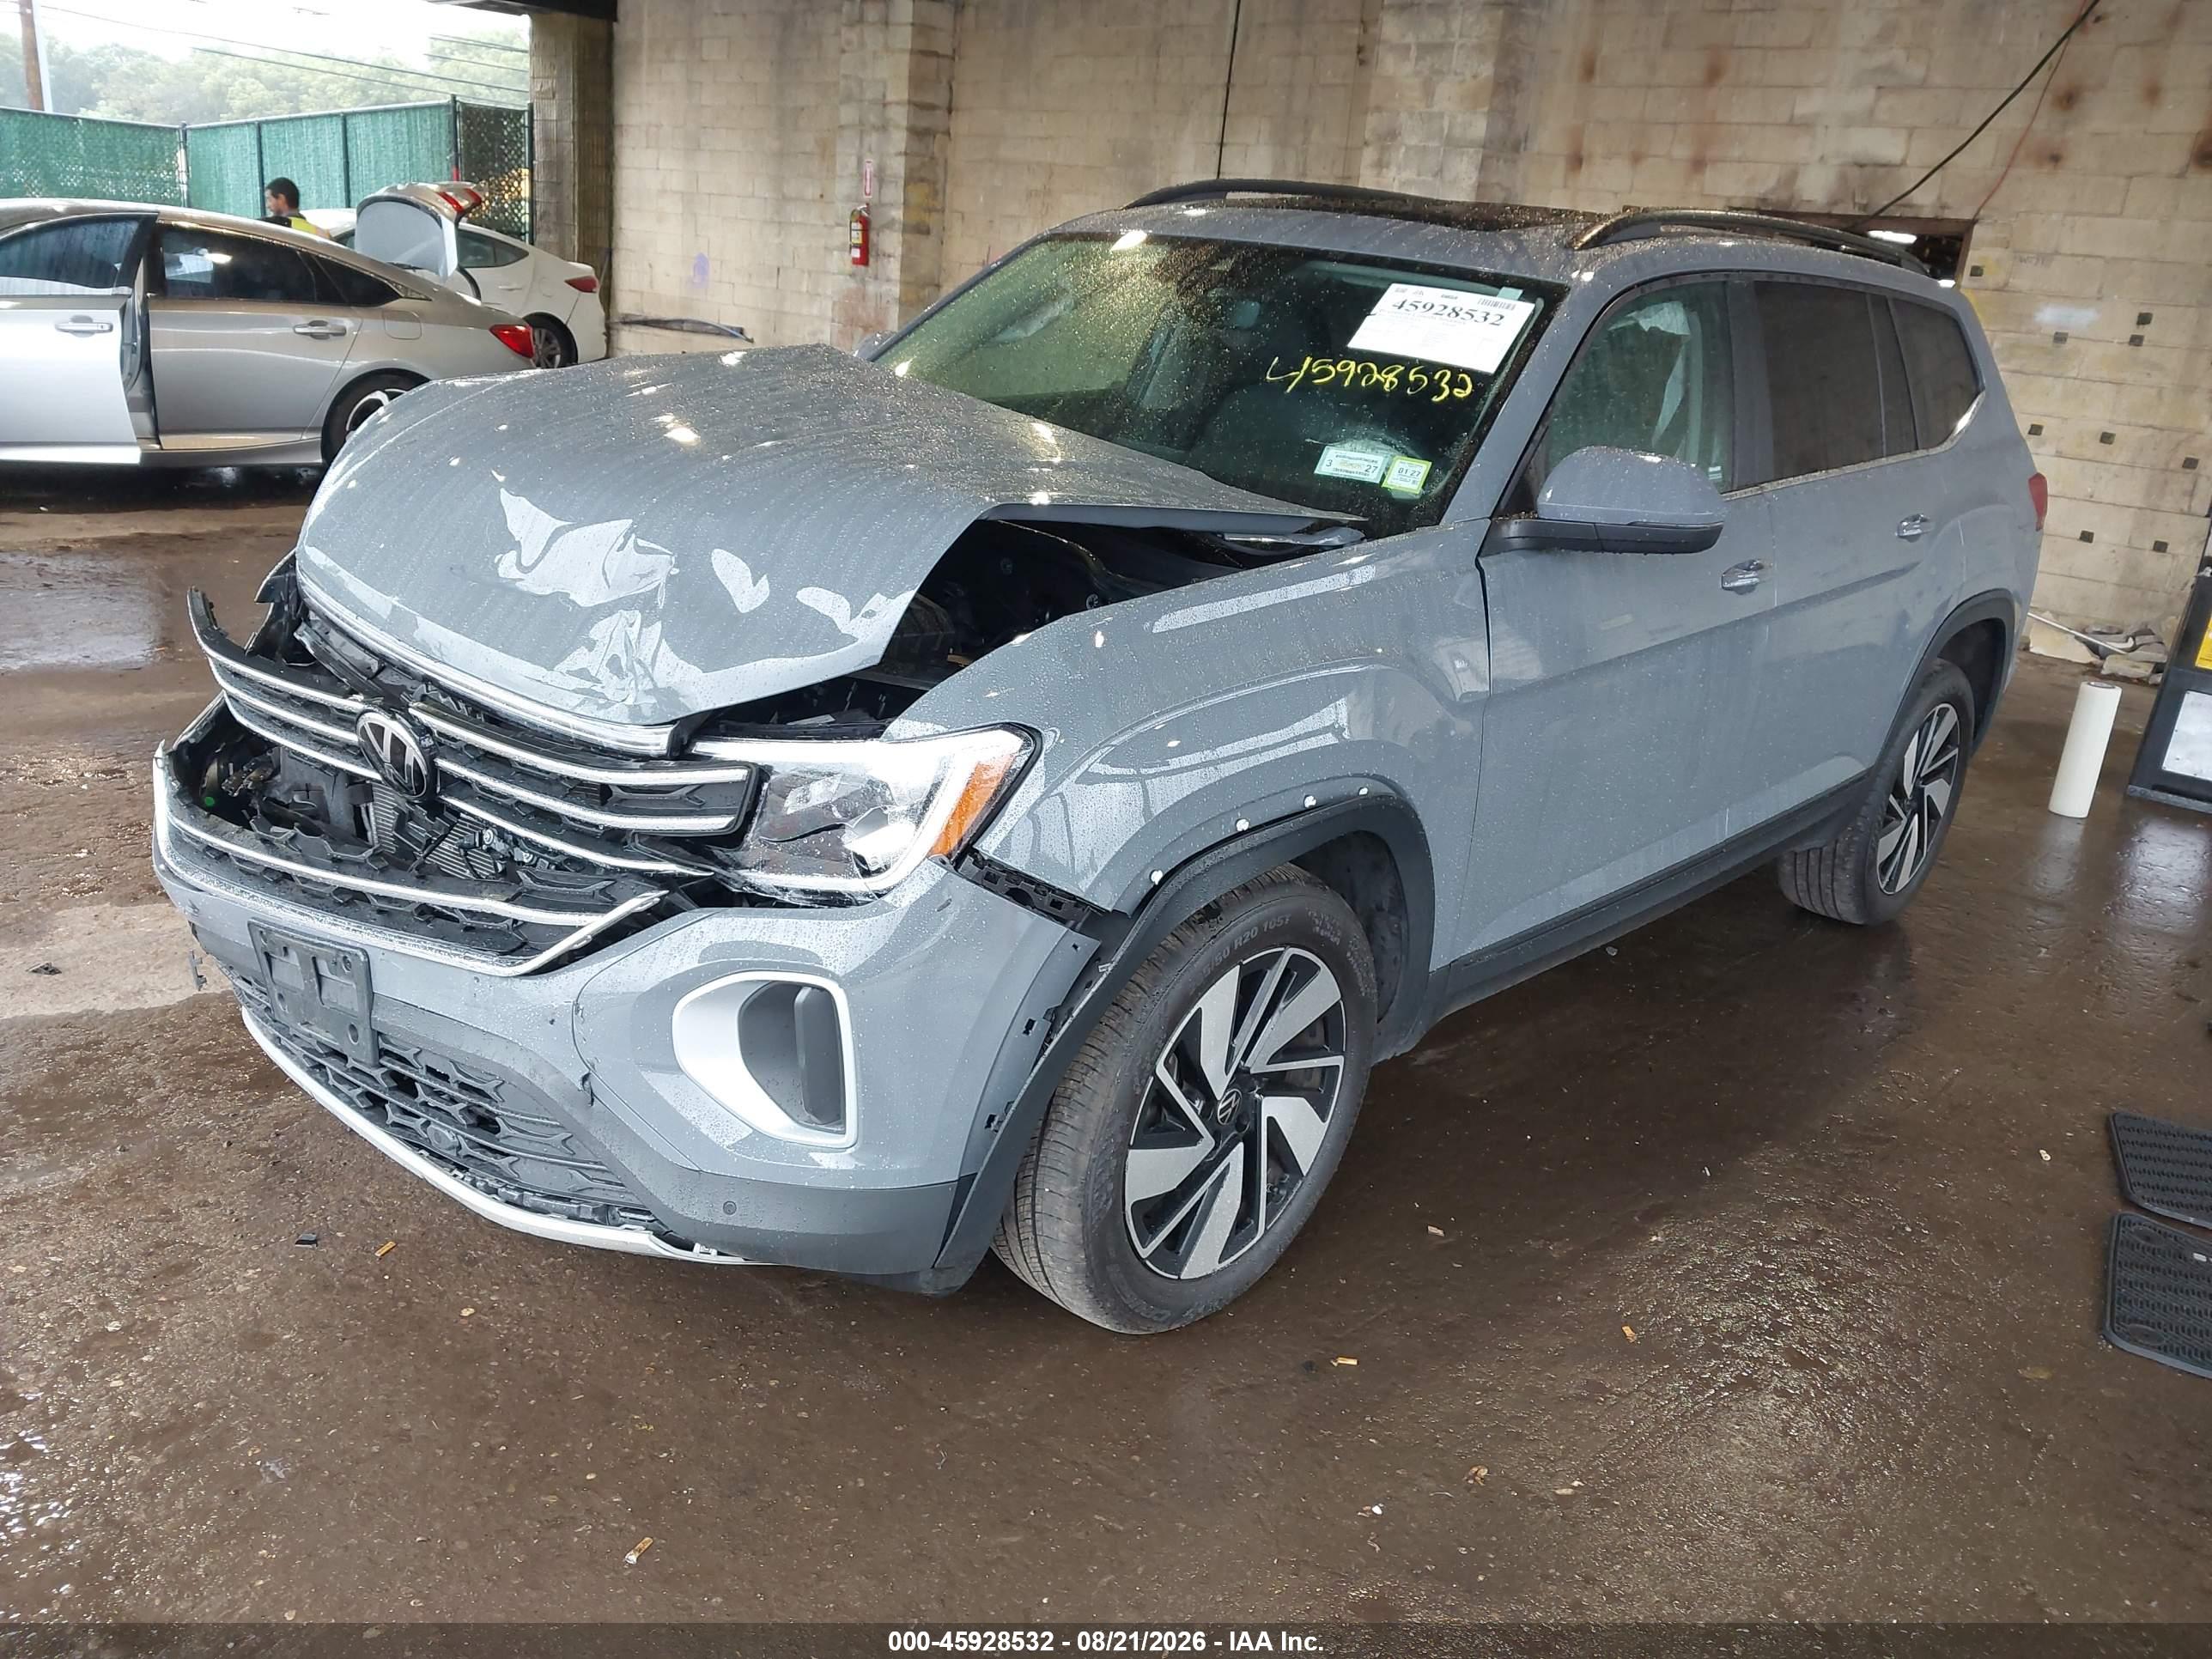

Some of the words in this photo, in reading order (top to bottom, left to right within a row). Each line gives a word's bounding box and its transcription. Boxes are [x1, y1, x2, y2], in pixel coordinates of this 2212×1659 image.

[1392, 299, 1504, 326] 45928532
[1266, 356, 1473, 401] 45928532
[1364, 465, 1378, 474] 27
[1234, 927, 1259, 951] R20
